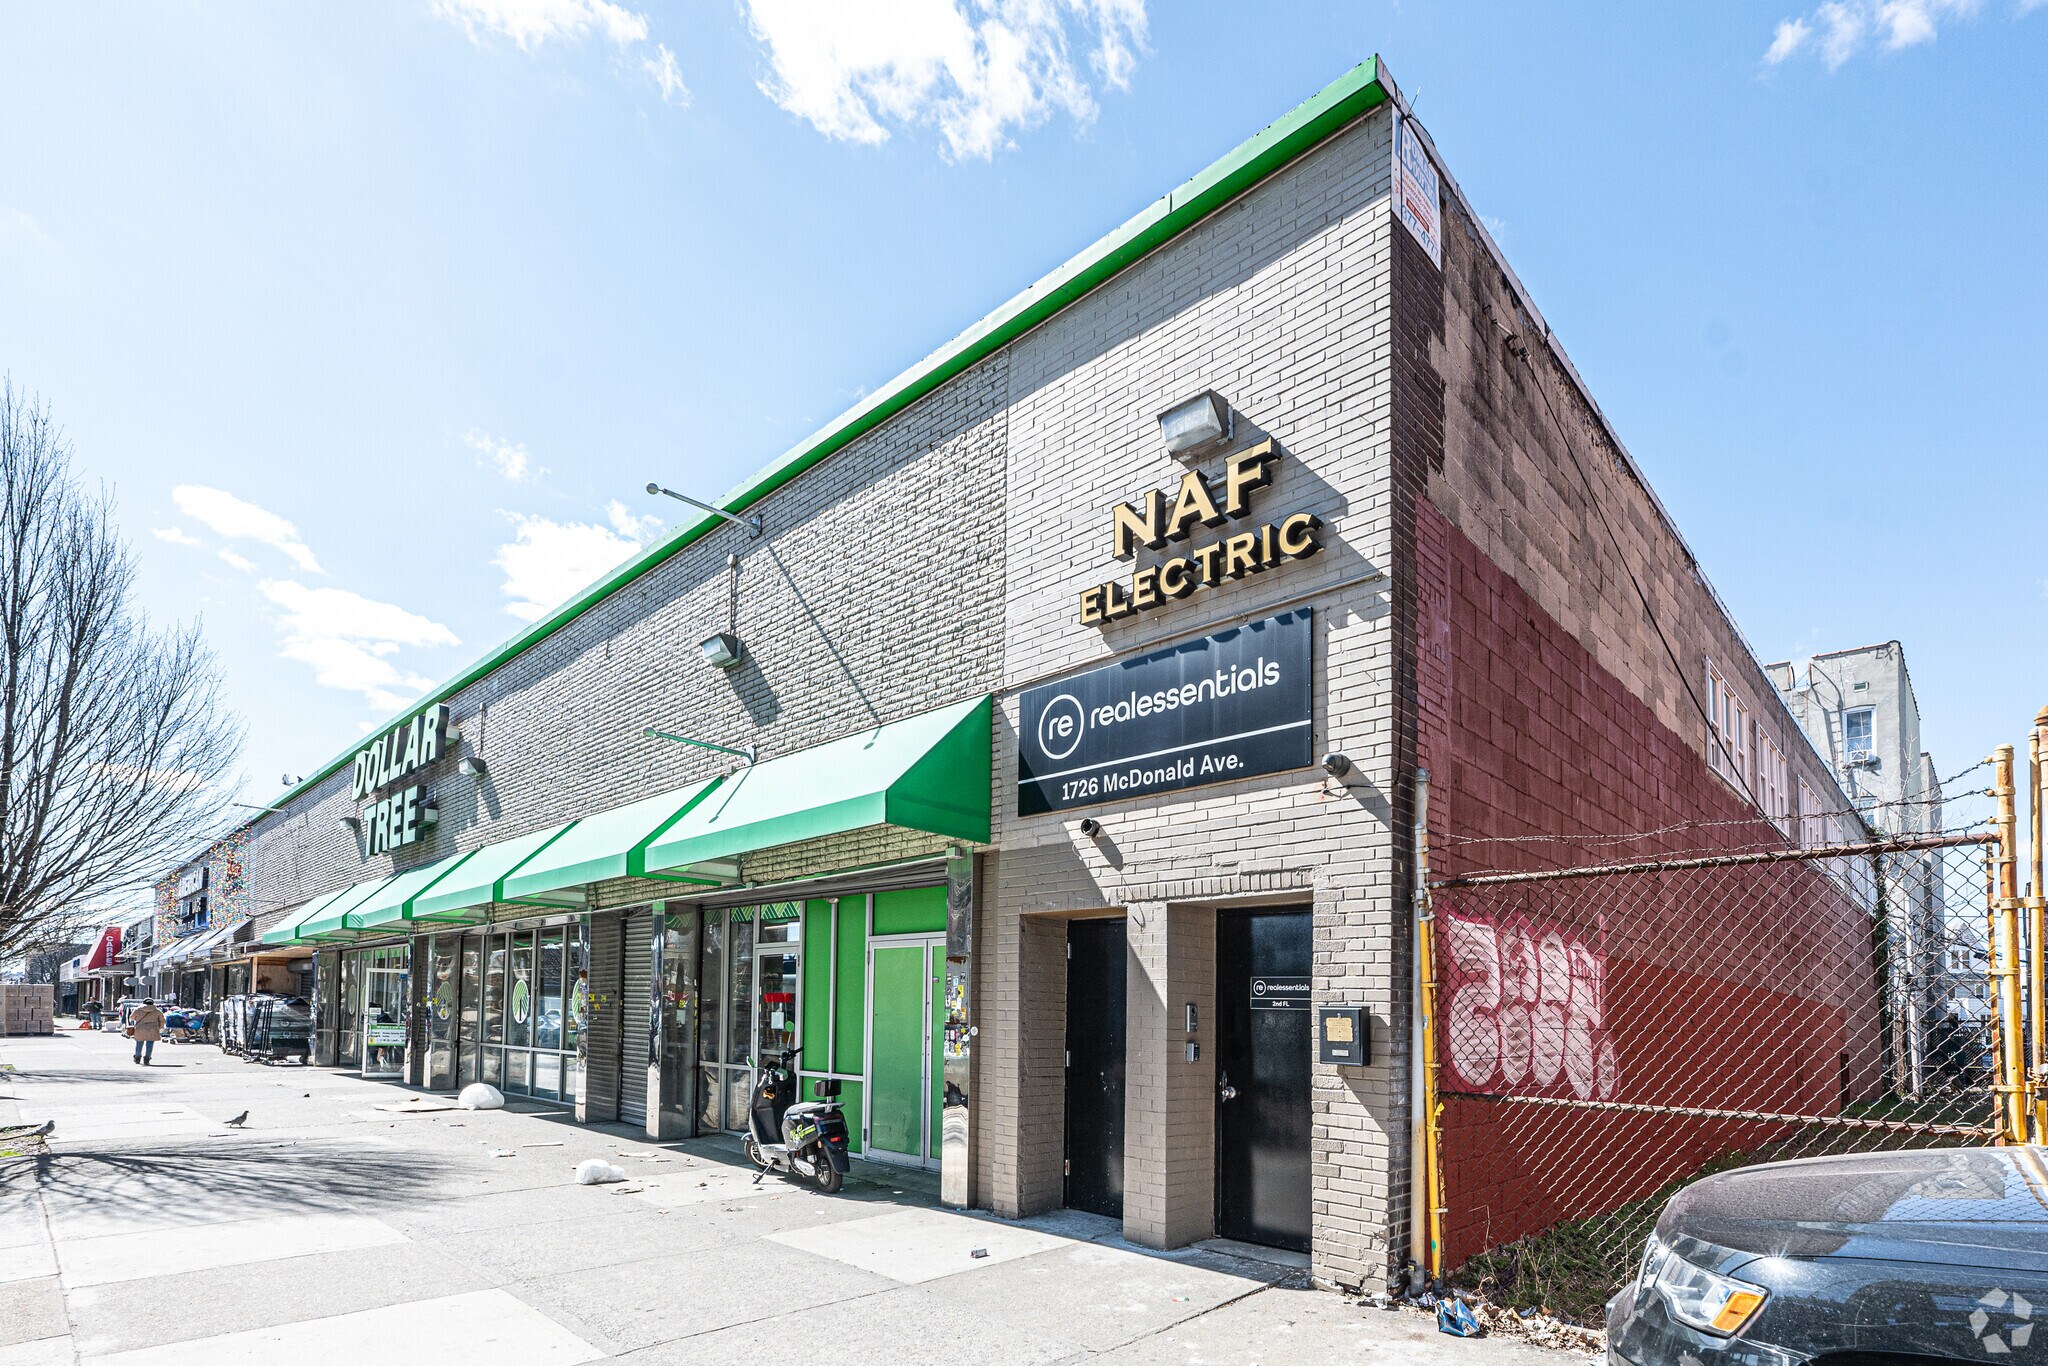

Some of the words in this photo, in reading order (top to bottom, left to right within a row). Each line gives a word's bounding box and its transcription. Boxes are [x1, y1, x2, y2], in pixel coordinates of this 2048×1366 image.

[1111, 436, 1281, 561] NAF
[1080, 513, 1322, 627] ELECTRIC
[1047, 715, 1074, 741] re
[1090, 656, 1280, 730] realessentials
[351, 702, 443, 801] DOLLAR
[1062, 779, 1099, 801] 1726
[1103, 756, 1195, 793] McDonald
[1199, 752, 1245, 776] Ave.
[363, 784, 423, 857] TREE
[1266, 983, 1310, 991] realessentials
